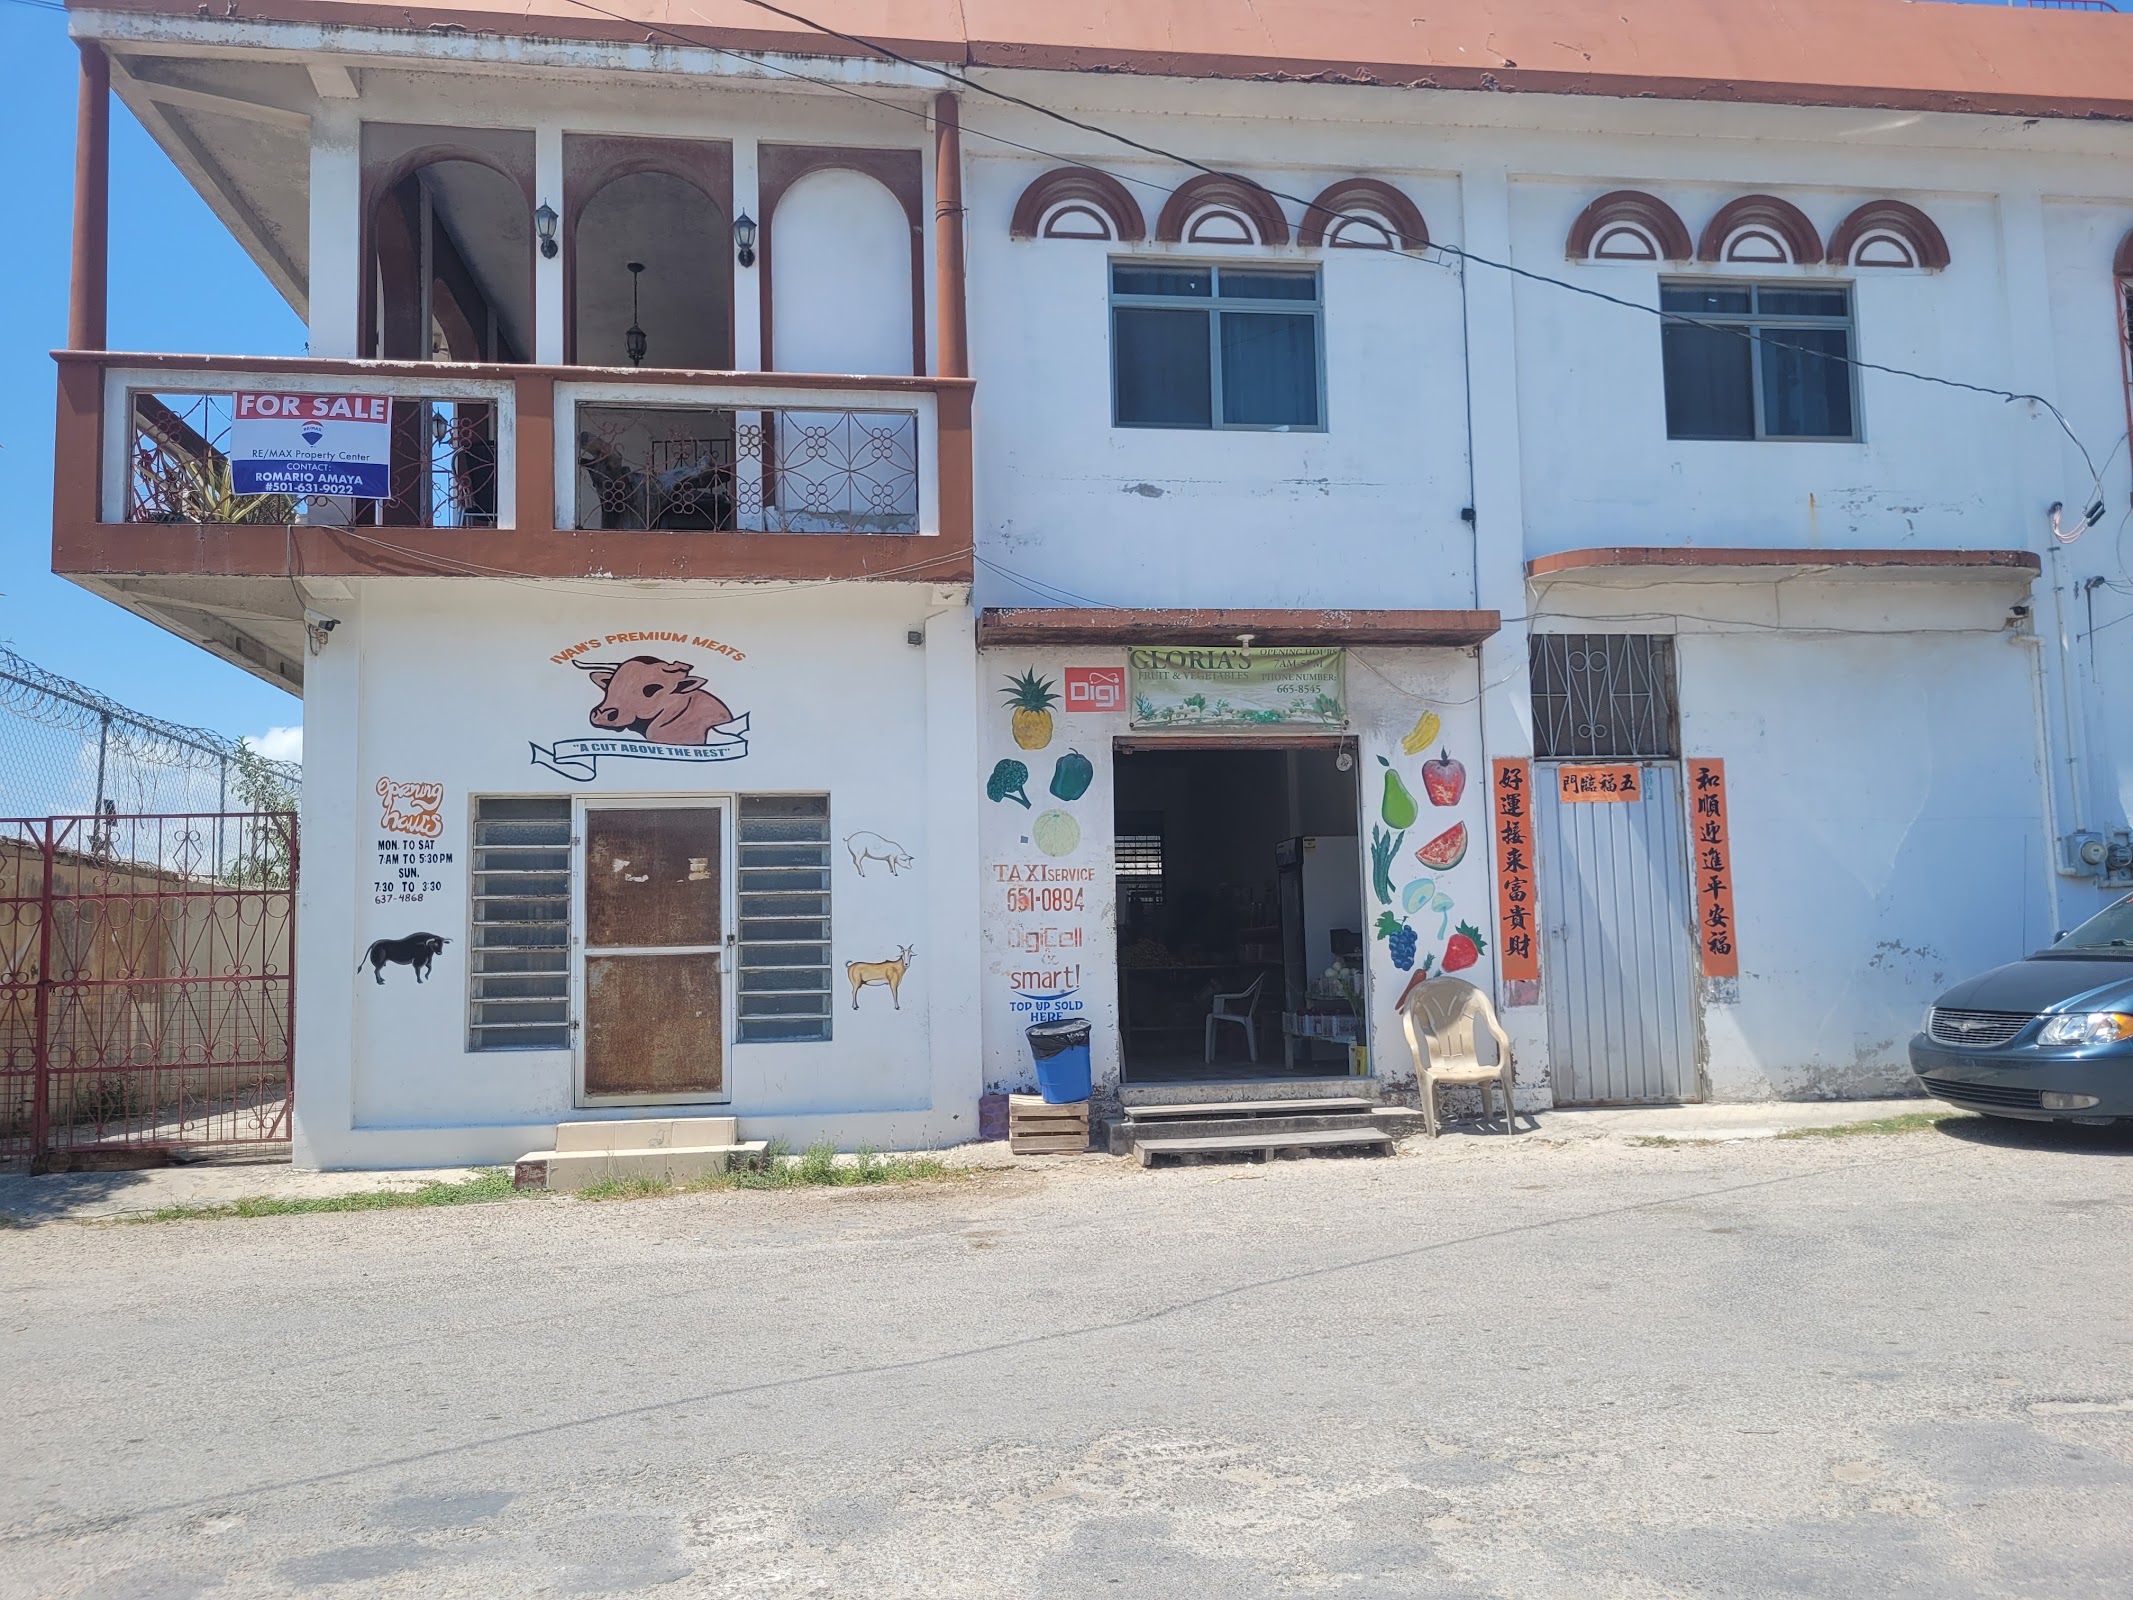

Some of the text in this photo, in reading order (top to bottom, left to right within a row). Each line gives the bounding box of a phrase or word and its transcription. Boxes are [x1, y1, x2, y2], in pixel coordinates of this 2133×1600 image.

[240, 395, 385, 420] FOR SALE
[252, 449, 370, 462] RE/MAX Property Center
[286, 463, 332, 472] CONTACT:
[255, 472, 363, 485] ROMARIO AMAYA
[265, 482, 354, 495] #501-631-9022
[549, 631, 747, 665] IVAN'S PREMIUM MEATS
[1260, 648, 1337, 656] OPENING HOURS
[1130, 650, 1252, 670] GLORIA'S
[1138, 671, 1249, 681] FRUIT & VEGETABLES
[1261, 673, 1337, 681] PHONE NUMBER:
[1070, 676, 1120, 707] Digi
[1276, 684, 1321, 694] 665-8545
[591, 743, 617, 753] CUT
[621, 744, 664, 755] ABOVE
[666, 747, 692, 757] THE
[403, 840, 415, 850] TO
[418, 840, 435, 850] SAT
[403, 853, 416, 864] TO
[398, 868, 420, 878] SUN.
[375, 881, 442, 892] 7:30 TO 3:30
[375, 893, 424, 904] 637-4868
[1010, 964, 1080, 989] smart!
[1010, 1001, 1083, 1011] TOP UP SOLD
[1030, 1012, 1063, 1022] HERE
